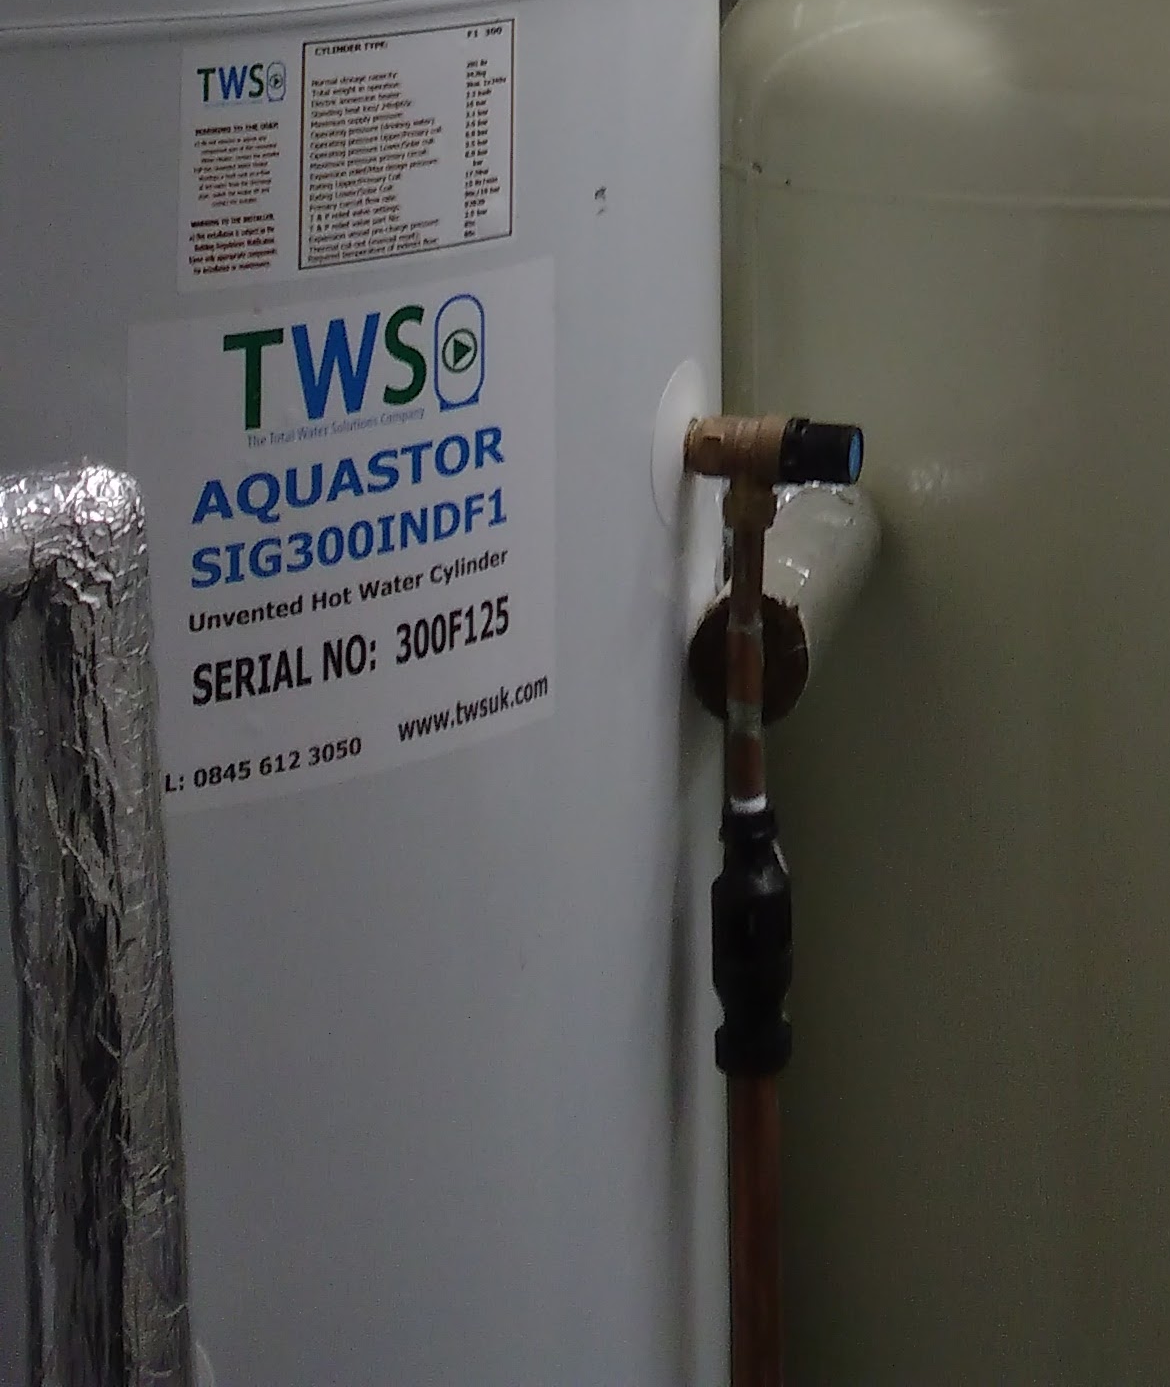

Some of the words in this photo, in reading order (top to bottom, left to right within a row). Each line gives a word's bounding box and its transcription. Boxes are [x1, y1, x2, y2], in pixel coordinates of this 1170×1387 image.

[196, 63, 264, 102] TWS
[222, 304, 427, 430] TWS
[247, 434, 267, 448] The
[269, 431, 295, 445] Total
[297, 425, 329, 442] Water
[331, 416, 379, 436] Solutions
[380, 407, 426, 427] Company
[191, 426, 505, 525] AQUASTOR
[191, 488, 507, 589] SIG300INDF1
[188, 595, 303, 633] Unvented
[311, 586, 352, 613] Hot
[359, 571, 424, 603] Water
[430, 548, 508, 586] Cylinder
[192, 645, 312, 707] SERIAL
[322, 634, 377, 683] NO:
[396, 595, 510, 666] 300F125
[397, 674, 549, 743] www.twsuk.com
[193, 760, 251, 790] 0845
[258, 750, 302, 778] 612
[308, 736, 362, 768] 3050
